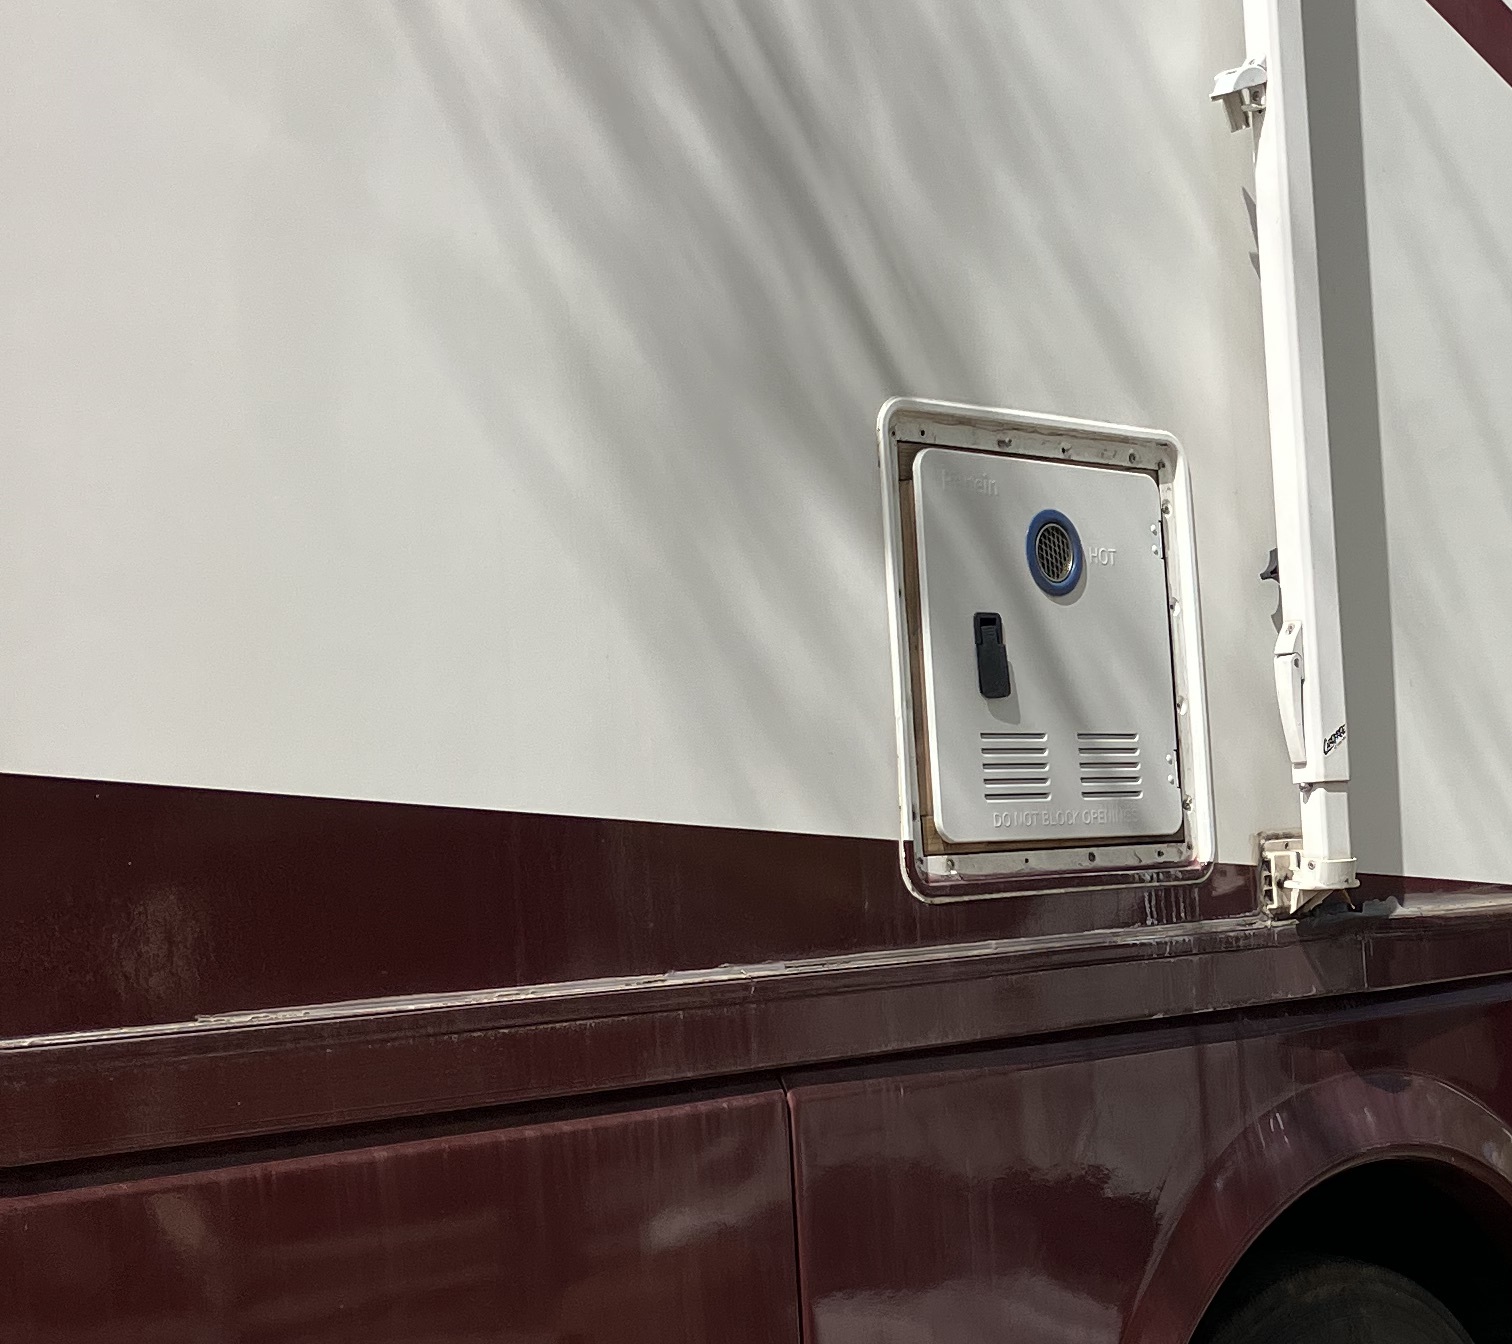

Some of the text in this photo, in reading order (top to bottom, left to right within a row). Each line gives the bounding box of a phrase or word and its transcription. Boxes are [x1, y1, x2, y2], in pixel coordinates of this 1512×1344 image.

[1088, 546, 1117, 566] HOT
[993, 811, 1011, 828] DO
[1014, 810, 1039, 826] NOT
[1042, 809, 1081, 825] BLOCK
